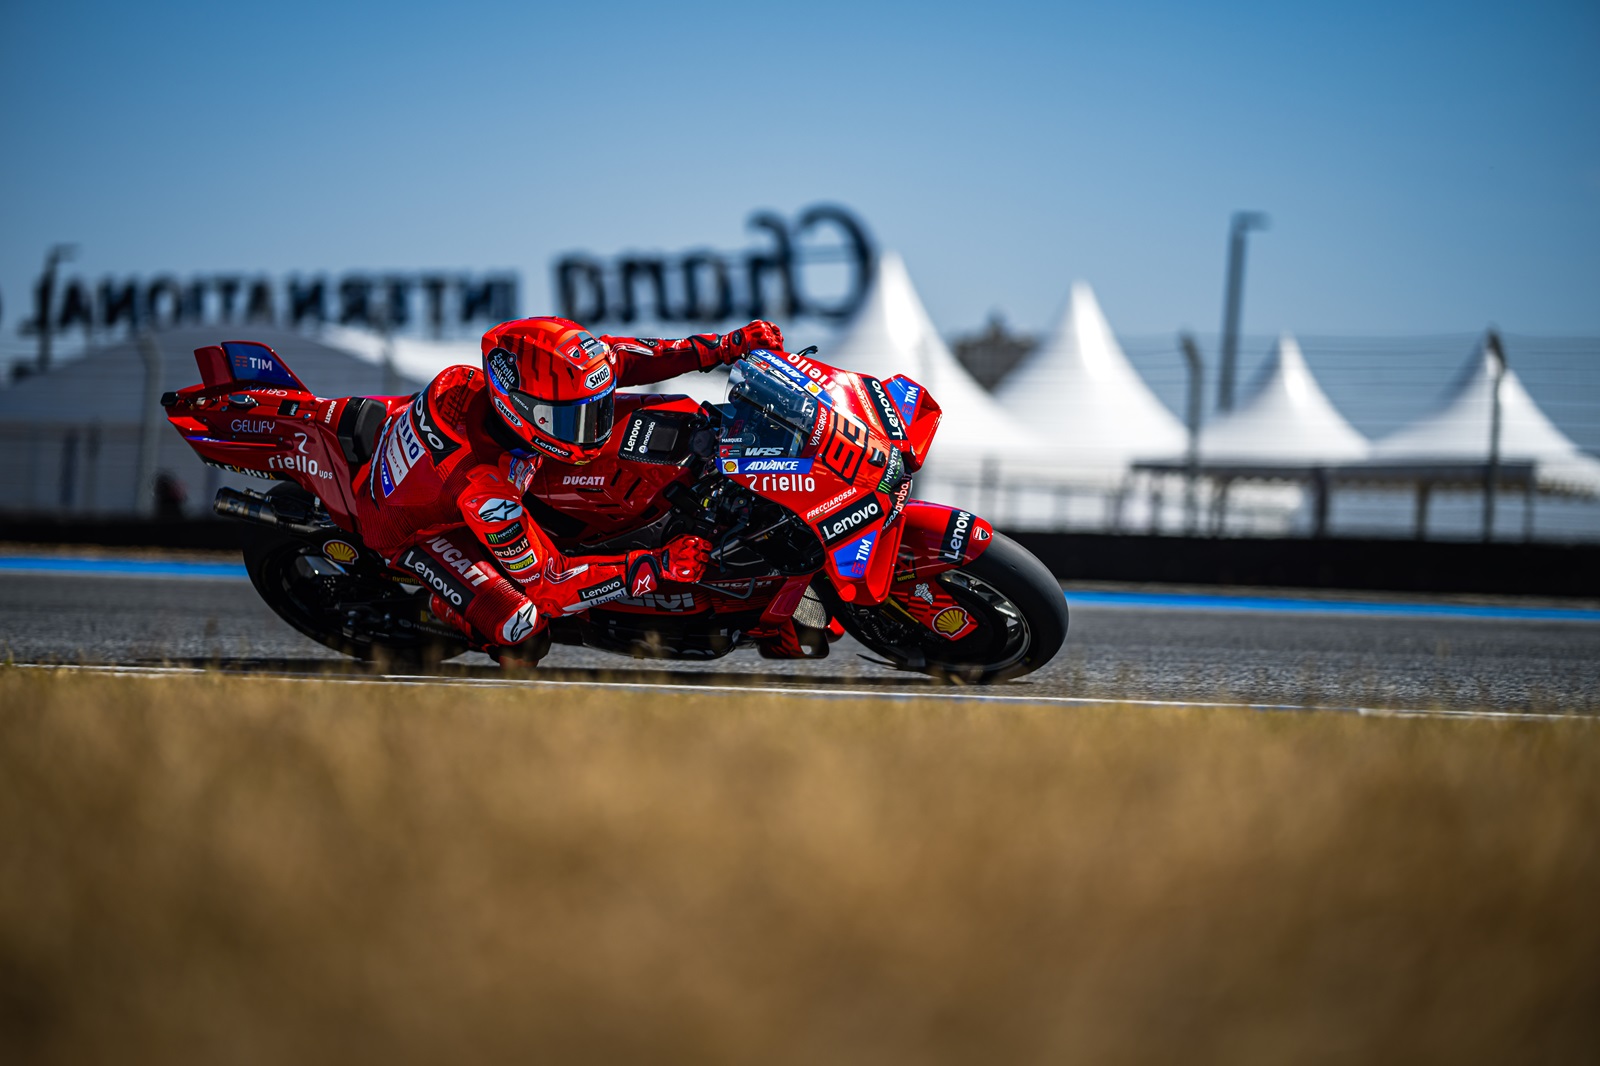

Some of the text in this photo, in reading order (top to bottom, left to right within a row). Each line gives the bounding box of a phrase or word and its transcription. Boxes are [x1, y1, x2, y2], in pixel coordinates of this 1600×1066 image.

[249, 357, 273, 371] TIM
[494, 353, 516, 384] Estrella
[787, 353, 836, 390] riello
[904, 386, 919, 404] TIM
[324, 401, 337, 424] DUCATI
[496, 400, 519, 425] SHOEI
[872, 380, 903, 440] Lenovo
[231, 419, 276, 434] GELLIFY
[624, 419, 643, 453] Lenovo
[644, 421, 656, 446] motorola
[810, 407, 828, 447] VARGROUP
[534, 438, 570, 457] Lenovo
[744, 447, 785, 457] WRS
[268, 455, 333, 480] riello ups
[744, 460, 799, 471] ADVANCE
[562, 476, 606, 486] DUCATI
[762, 474, 816, 492] riello
[806, 487, 858, 520] FRECCIAROSSA
[822, 503, 879, 540] Lenovo
[494, 538, 529, 558] aruba.it
[855, 538, 873, 561] TIM
[403, 551, 463, 606] Lenovo
[581, 580, 621, 599] Lenovo
